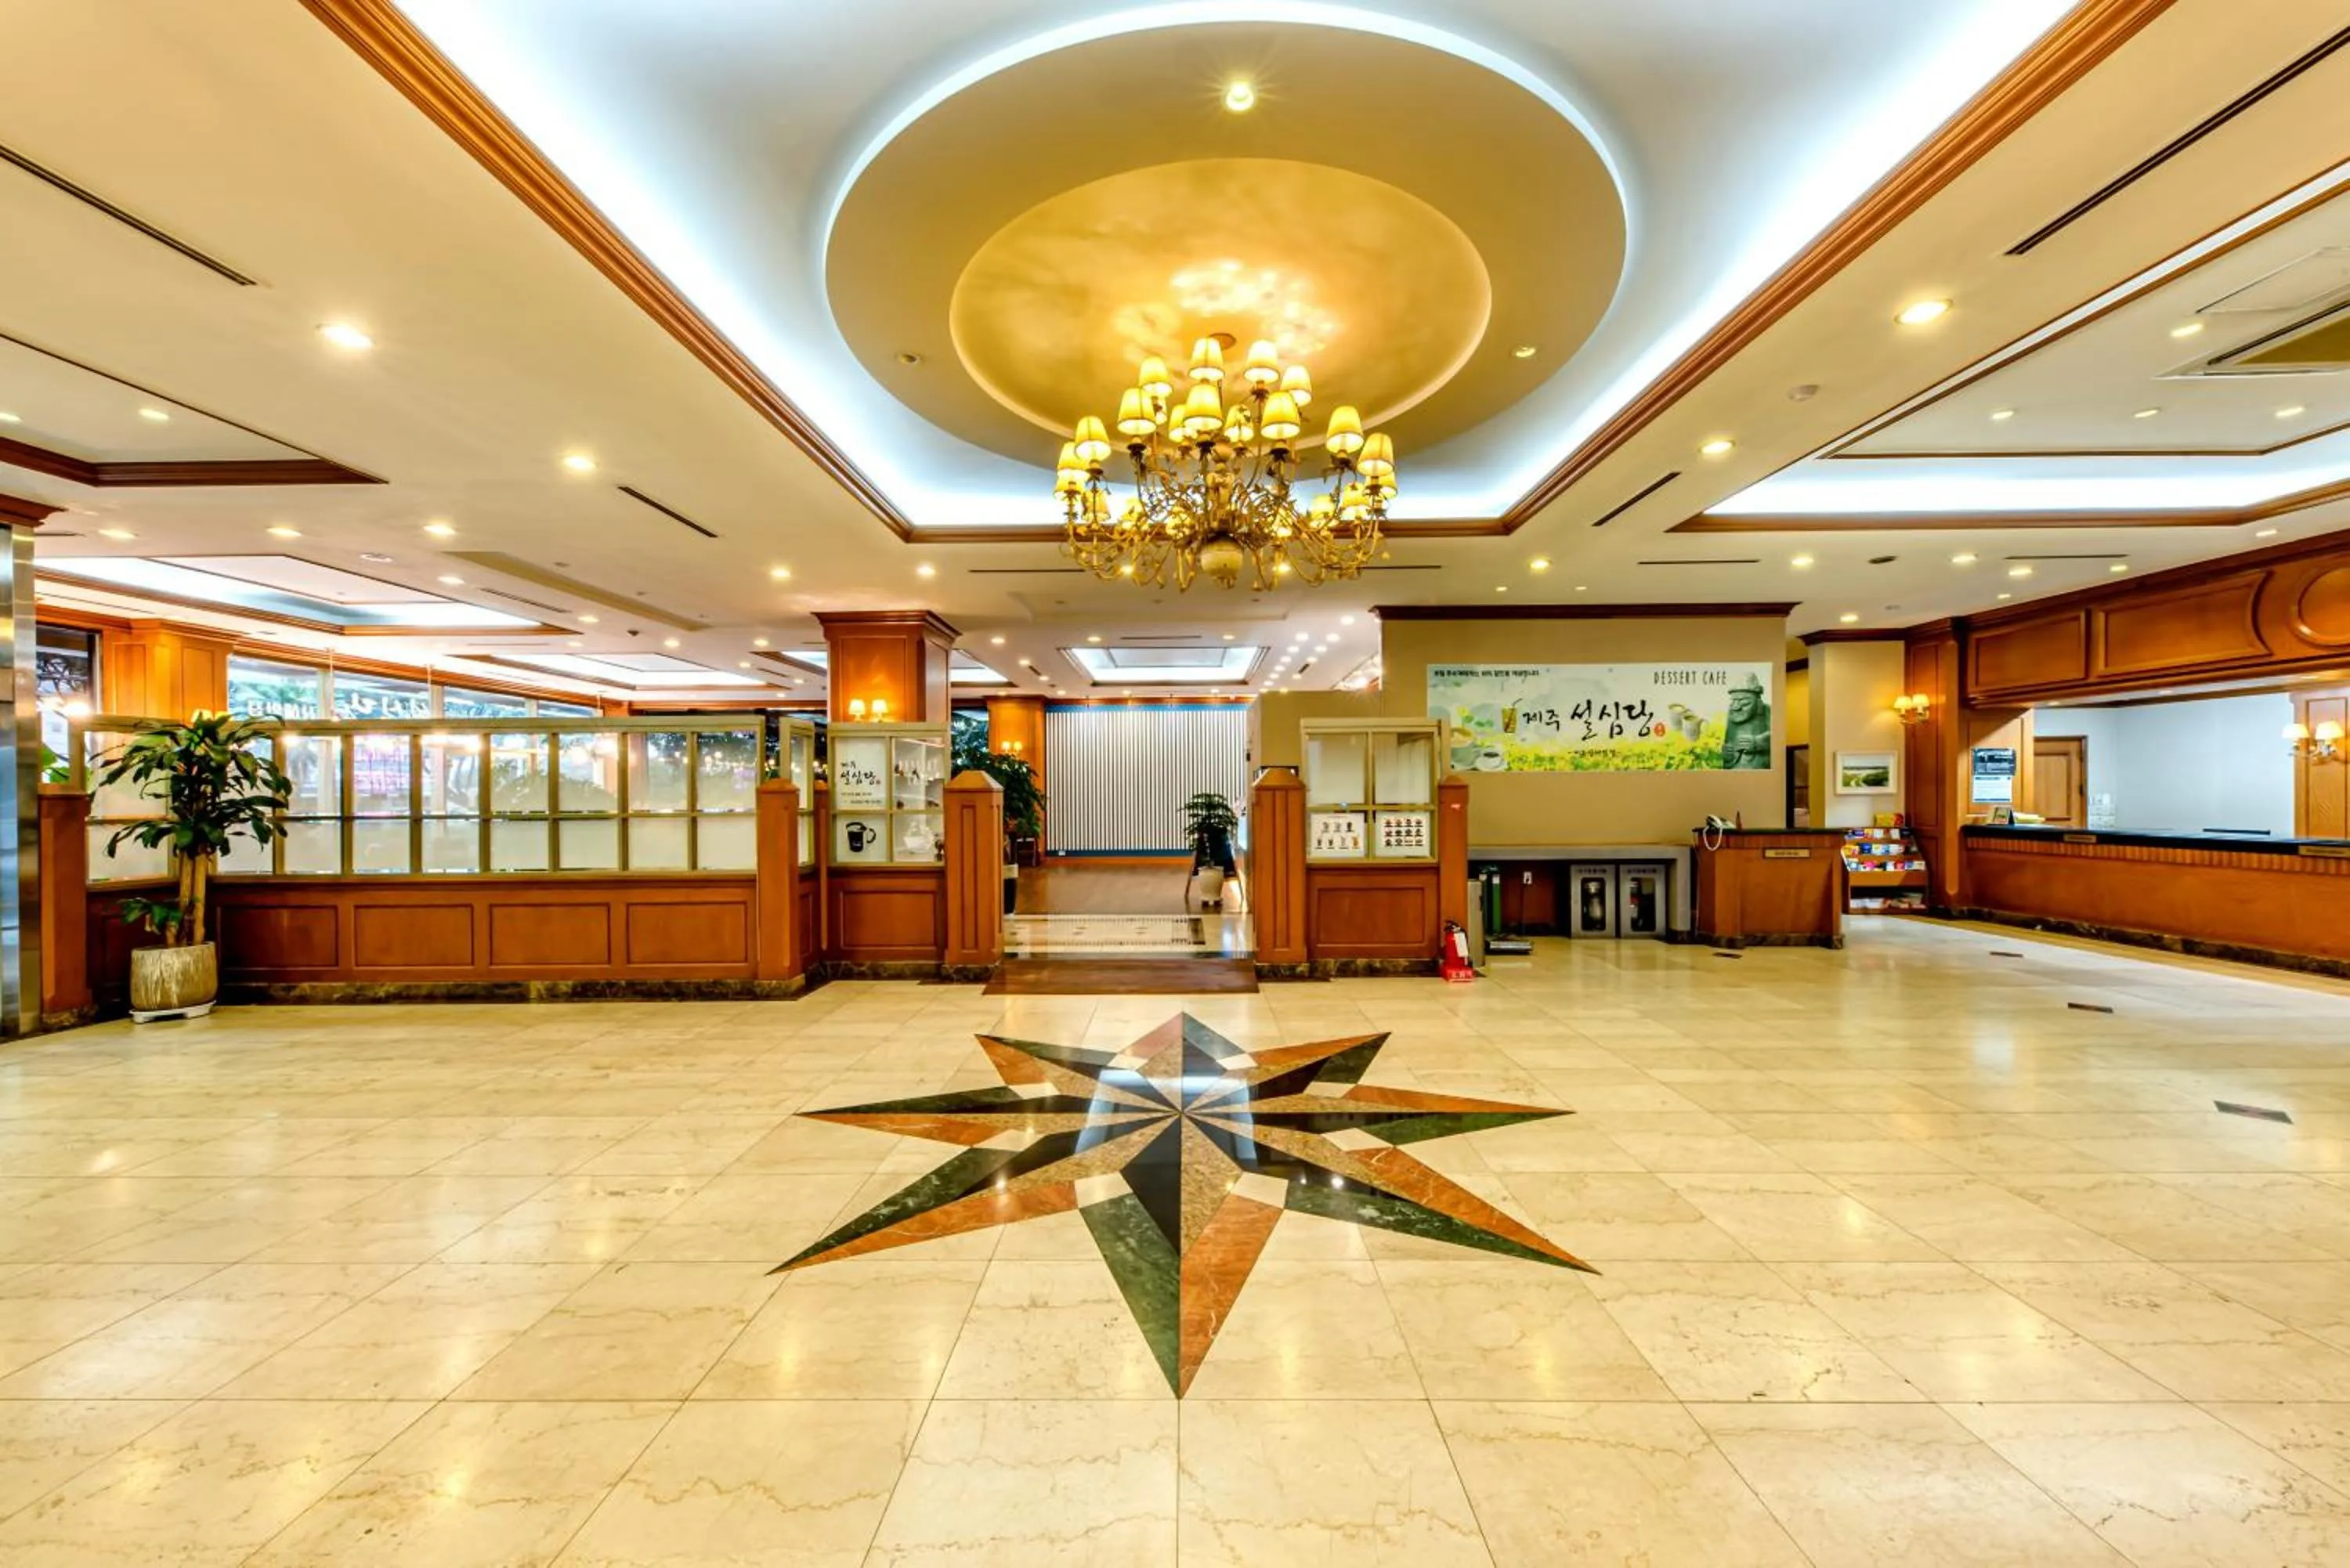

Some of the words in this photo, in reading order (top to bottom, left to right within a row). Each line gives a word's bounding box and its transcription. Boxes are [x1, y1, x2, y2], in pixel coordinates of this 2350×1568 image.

[1654, 670, 1696, 685] DESSERT
[1702, 670, 1726, 685] CAFE
[1522, 709, 1560, 732] 제주
[1571, 699, 1654, 741] 설심당
